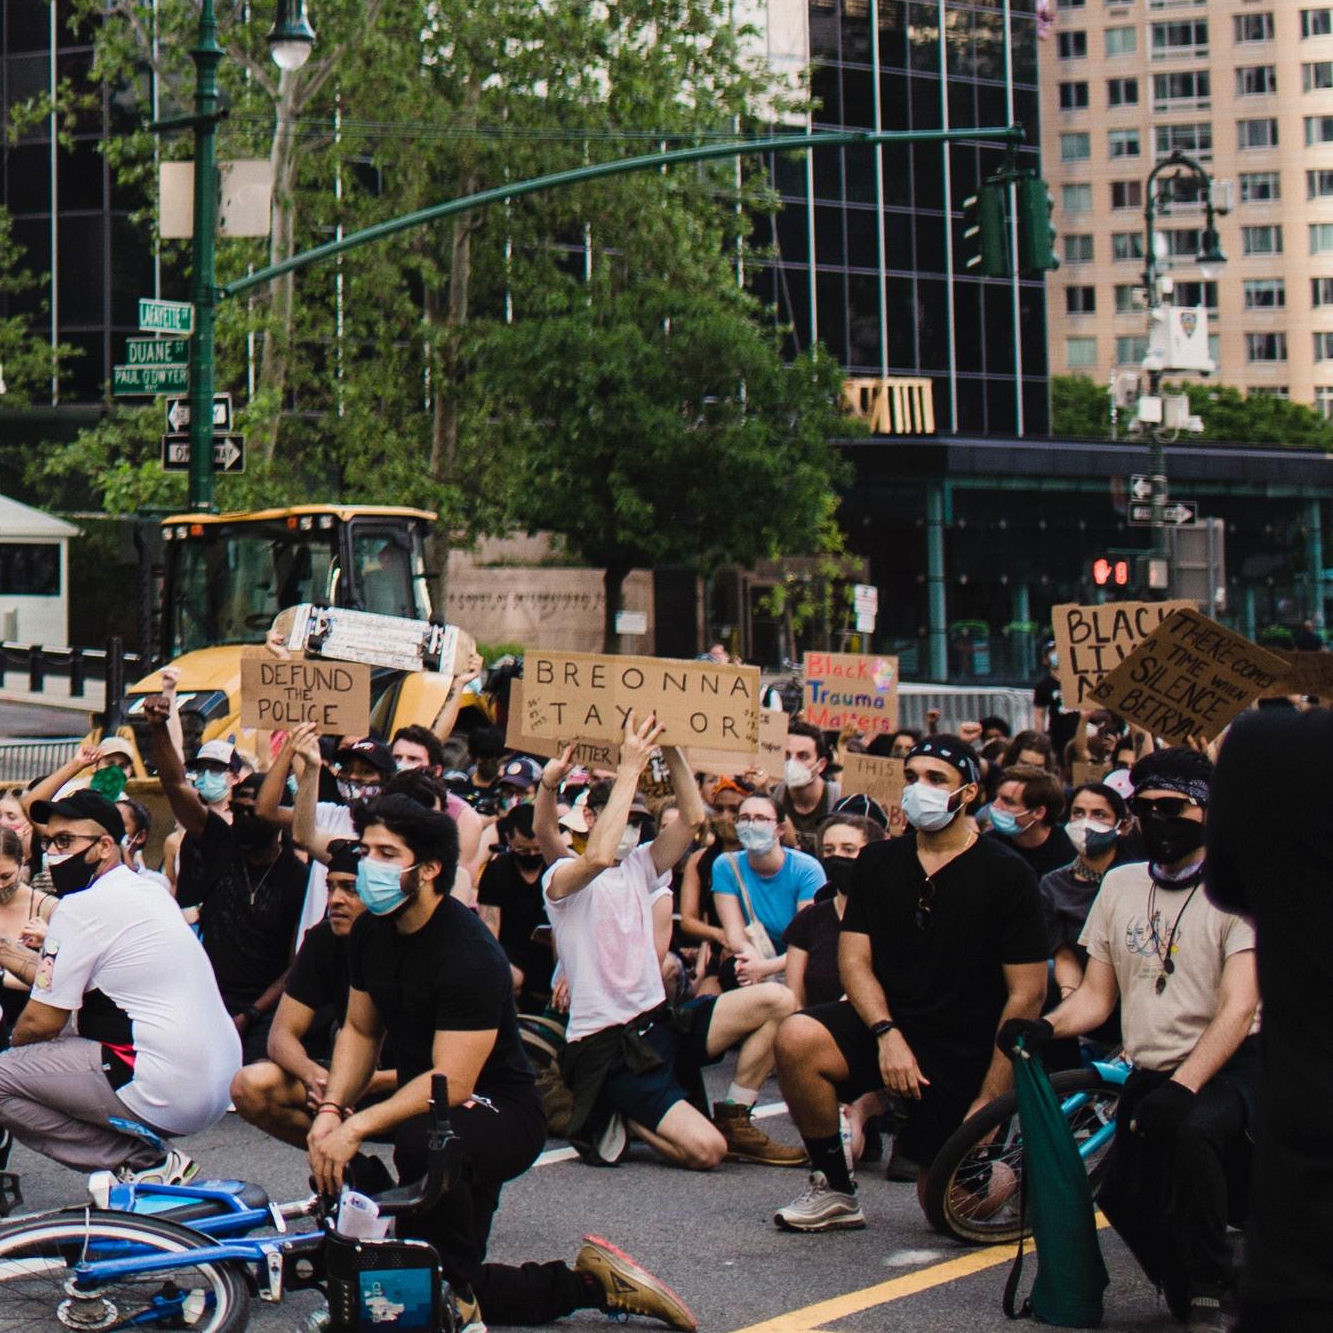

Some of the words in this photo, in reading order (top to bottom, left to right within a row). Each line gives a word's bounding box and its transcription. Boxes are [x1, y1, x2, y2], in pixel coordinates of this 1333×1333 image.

[129, 341, 173, 364] DUANE
[115, 369, 141, 385] PAUL
[1170, 612, 1246, 666] THERE
[260, 663, 353, 692] DEFUND
[537, 659, 750, 698] BREONNA
[807, 653, 867, 679] Black
[1167, 642, 1210, 679] TIME
[1211, 674, 1250, 702] WHEN
[283, 687, 314, 702] THE
[806, 679, 885, 709] Trauma
[1093, 681, 1114, 700] IS
[1130, 656, 1230, 722] SILENCE
[258, 698, 339, 725] POLICE
[854, 759, 895, 778] THIS
